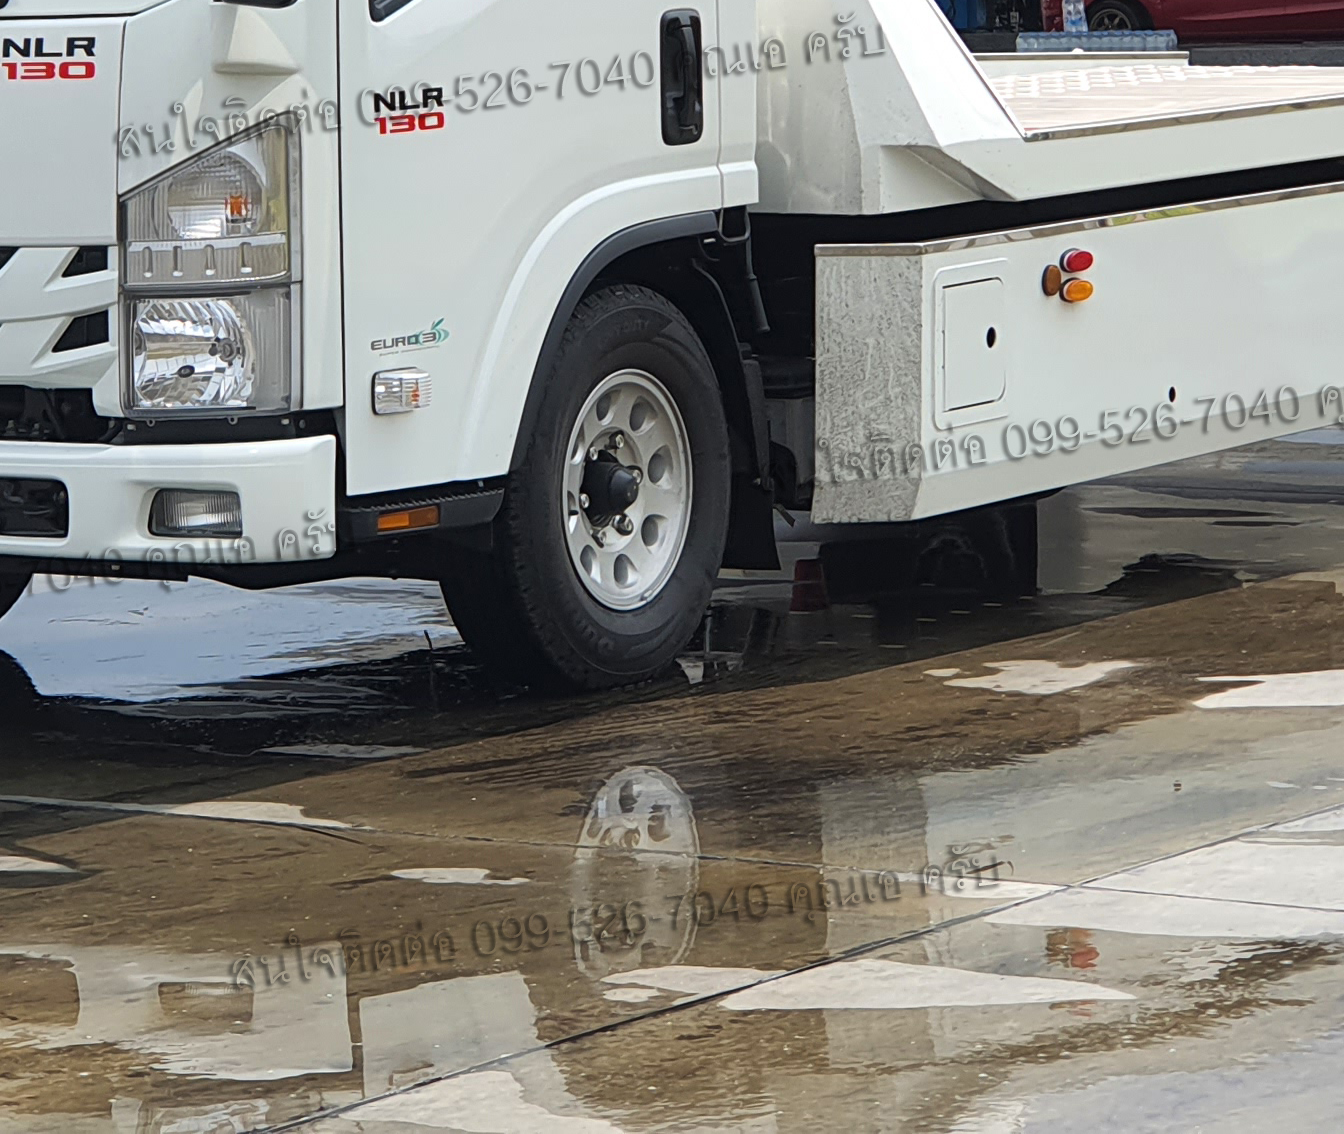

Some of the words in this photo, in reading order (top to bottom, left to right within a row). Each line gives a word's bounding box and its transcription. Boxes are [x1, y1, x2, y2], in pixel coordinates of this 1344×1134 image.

[2, 37, 96, 57] NLR
[1, 62, 96, 80] 130
[374, 87, 443, 112] NLR
[374, 112, 444, 134] 130
